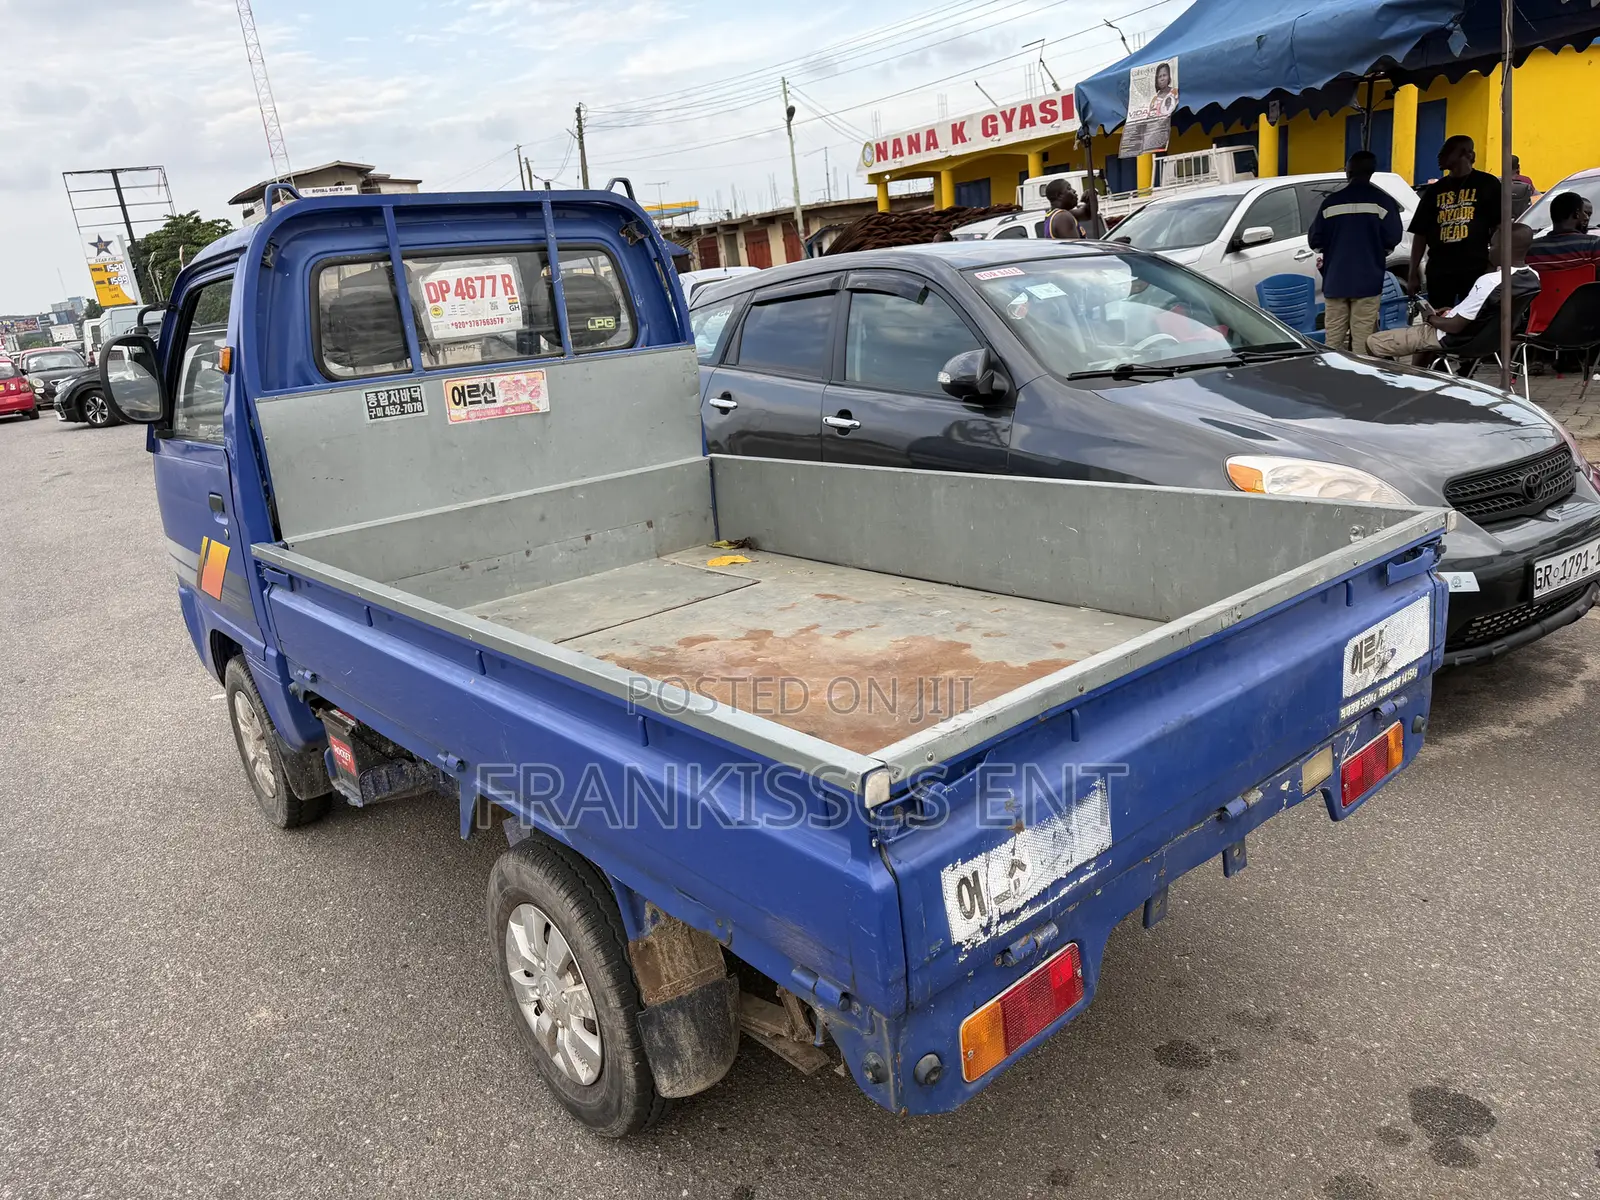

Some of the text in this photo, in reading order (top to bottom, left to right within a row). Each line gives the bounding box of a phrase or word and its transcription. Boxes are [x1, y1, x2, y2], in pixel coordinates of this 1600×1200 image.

[875, 93, 1075, 163] NANA K. GYASI
[1458, 188, 1477, 203] ALL
[1440, 225, 1468, 240] HEAD
[978, 267, 1021, 280] FOR SALE
[425, 274, 516, 304] DP 4677 R
[588, 318, 614, 329] LPG
[367, 385, 422, 407] 종합차바닥
[451, 382, 497, 407] 어르신
[369, 402, 423, 418] 구미 452-7078
[1535, 565, 1552, 590] GR
